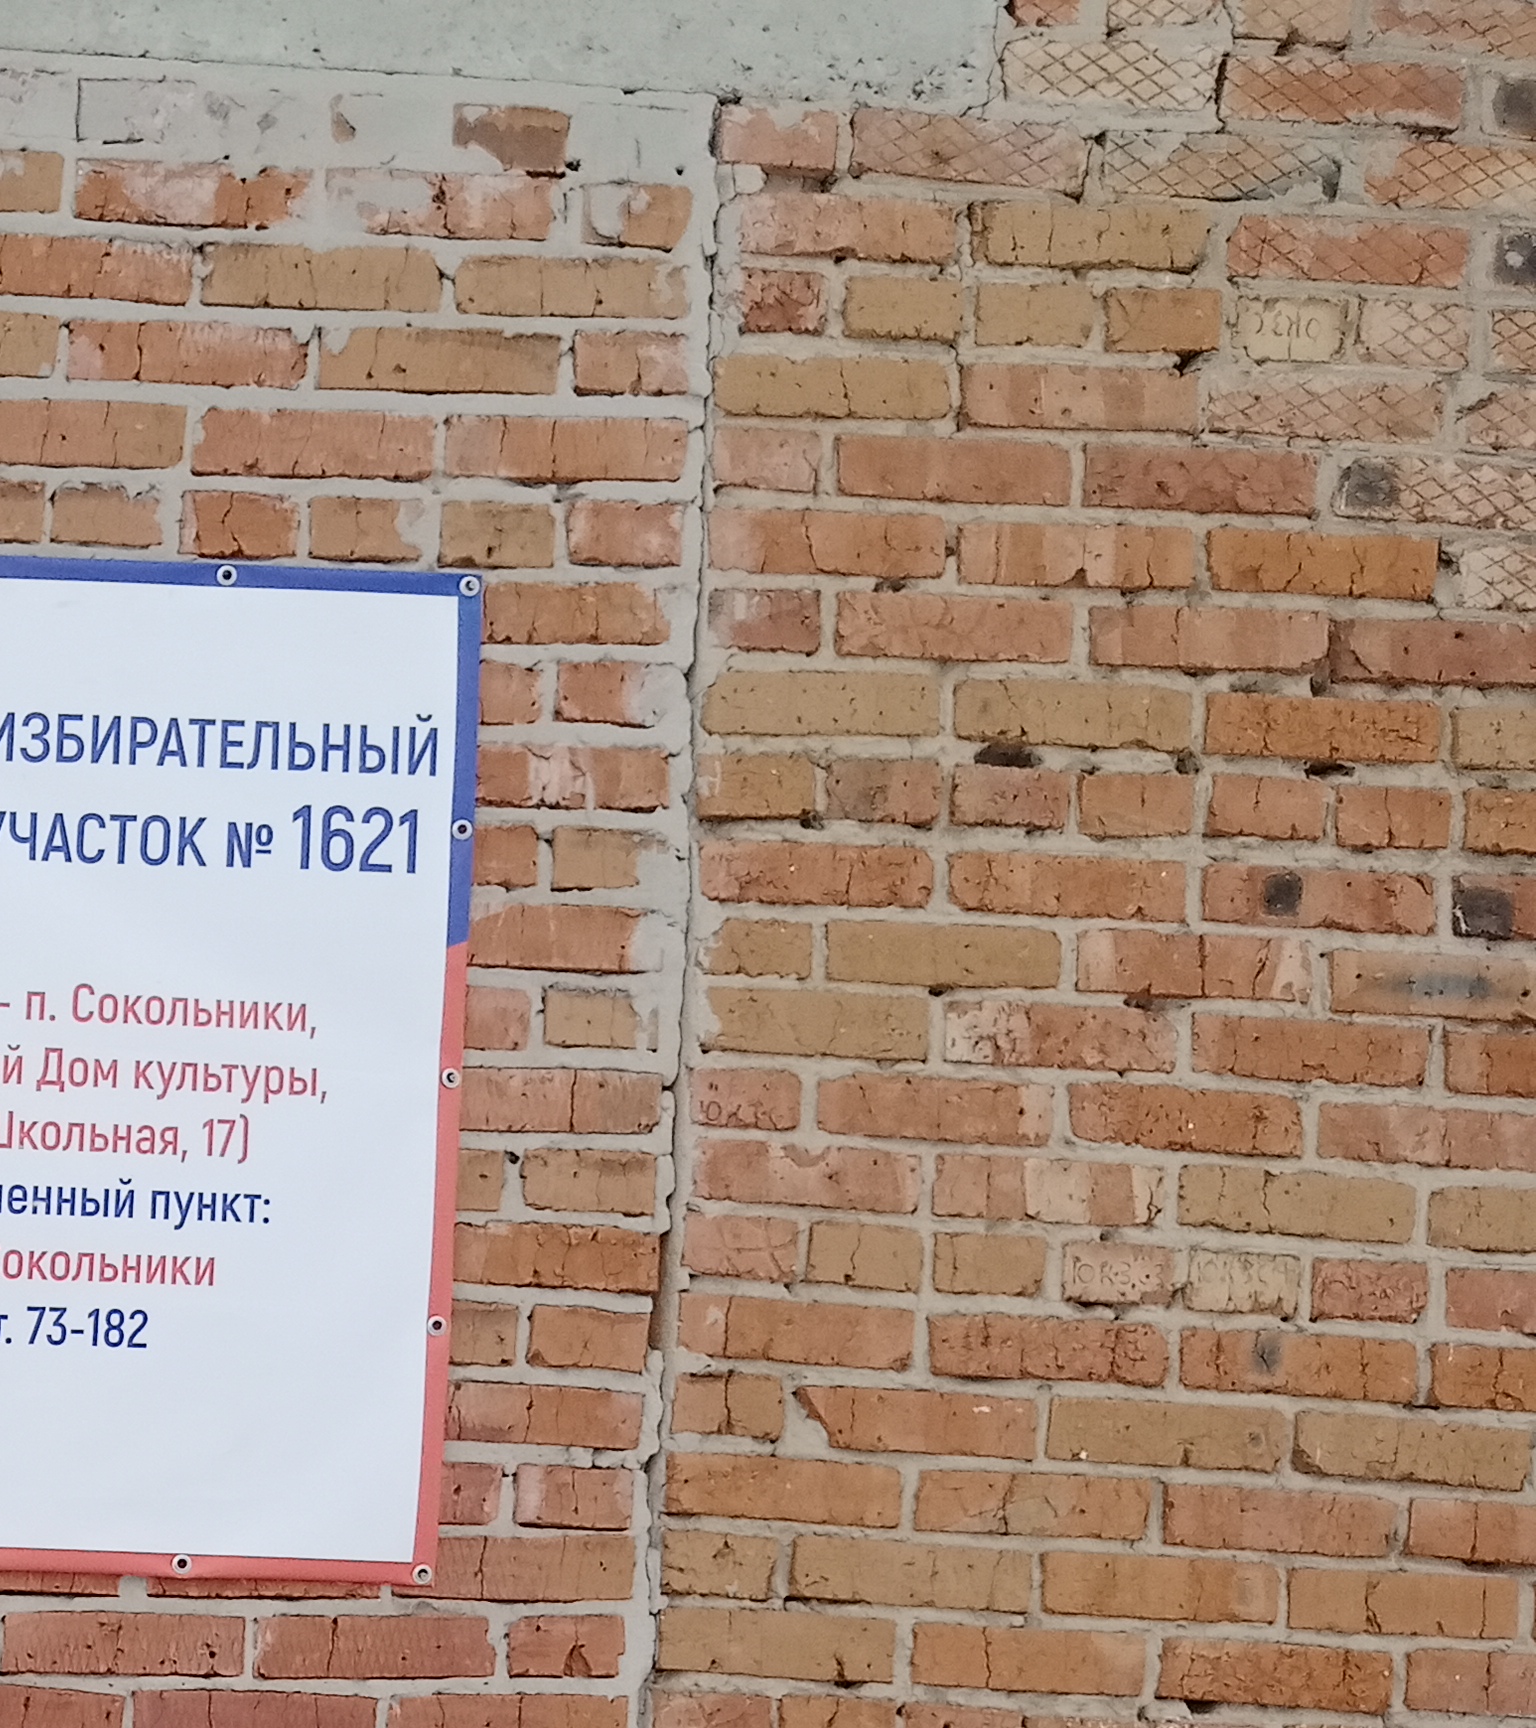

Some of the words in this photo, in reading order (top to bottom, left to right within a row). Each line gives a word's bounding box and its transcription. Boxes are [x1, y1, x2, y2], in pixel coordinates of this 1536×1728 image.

[226, 821, 274, 868] №
[291, 804, 420, 874] 1621
[25, 991, 57, 1022] п.
[71, 982, 318, 1038] Сокольники,
[36, 1047, 119, 1092] Дом
[133, 1056, 328, 1104] культуры,
[202, 1115, 250, 1165] 17)
[150, 1187, 272, 1230] пункт:
[27, 1306, 149, 1349] 73-182
